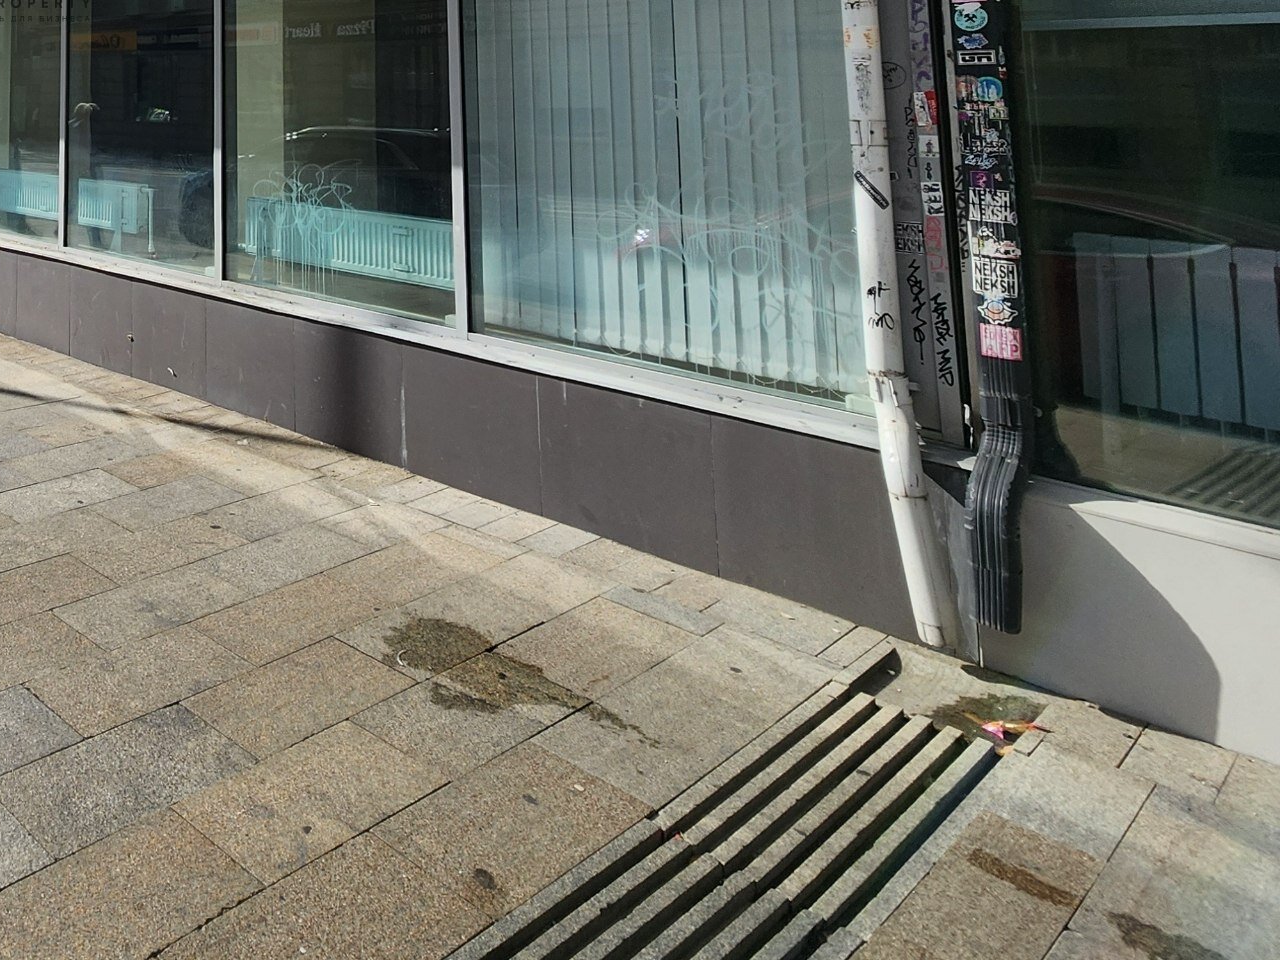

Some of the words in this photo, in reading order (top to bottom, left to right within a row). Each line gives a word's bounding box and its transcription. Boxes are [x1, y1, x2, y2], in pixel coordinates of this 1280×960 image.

[968, 189, 1010, 206] NEKSH
[968, 205, 1011, 222] NEKSH
[896, 236, 925, 252] EKSH
[974, 261, 1016, 280] NEKSH
[974, 278, 1016, 297] NEKSH
